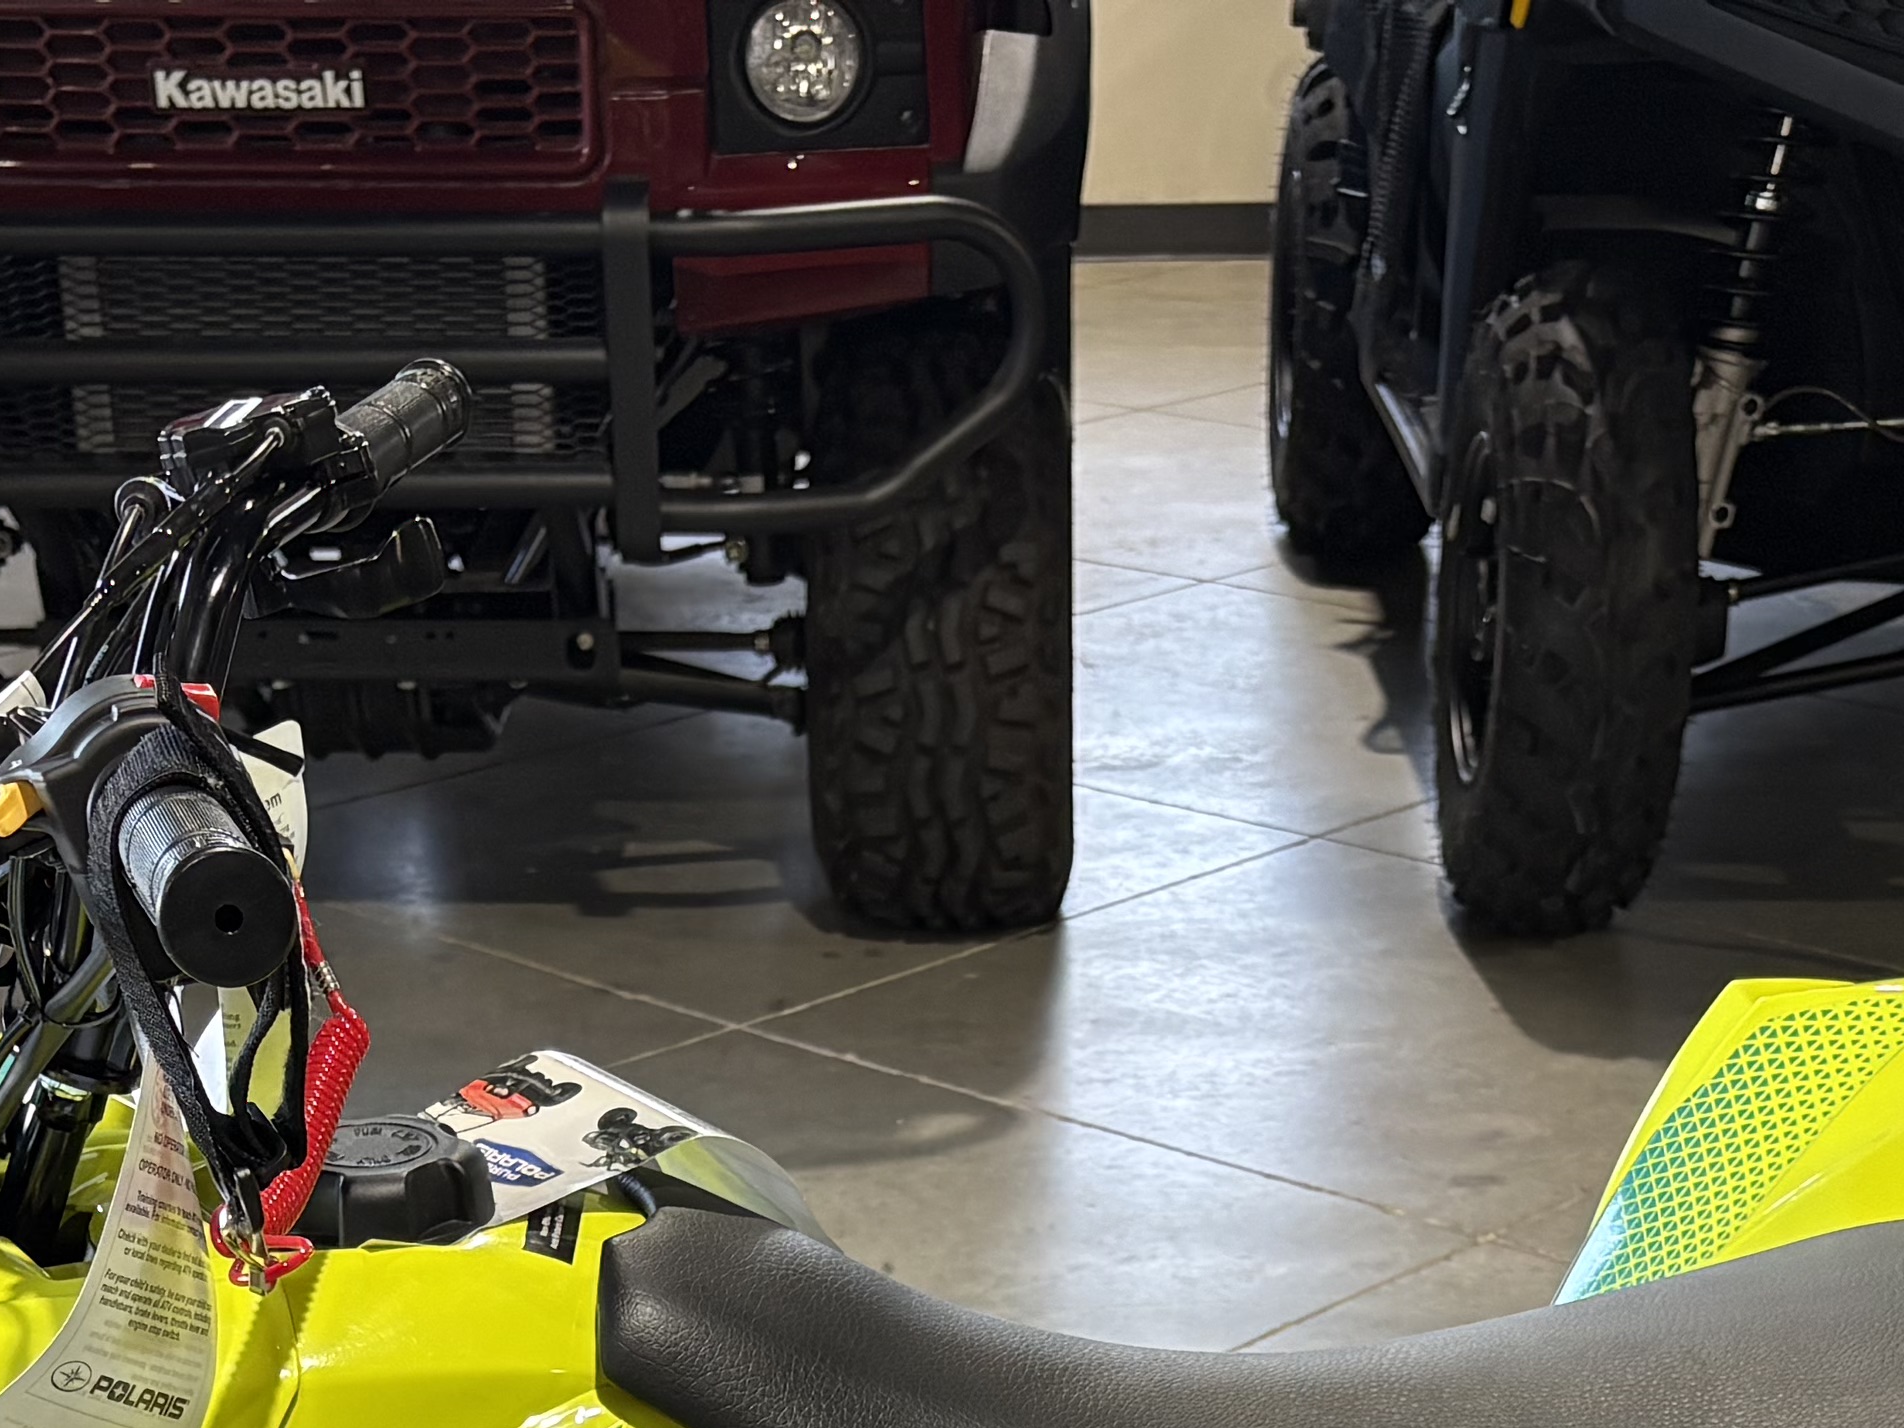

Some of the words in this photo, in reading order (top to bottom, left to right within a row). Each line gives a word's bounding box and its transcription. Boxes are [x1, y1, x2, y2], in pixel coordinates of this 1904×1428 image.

[154, 70, 365, 110] Kawasaki
[487, 1162, 522, 1181] PUR
[89, 1375, 189, 1420] POLARIS
